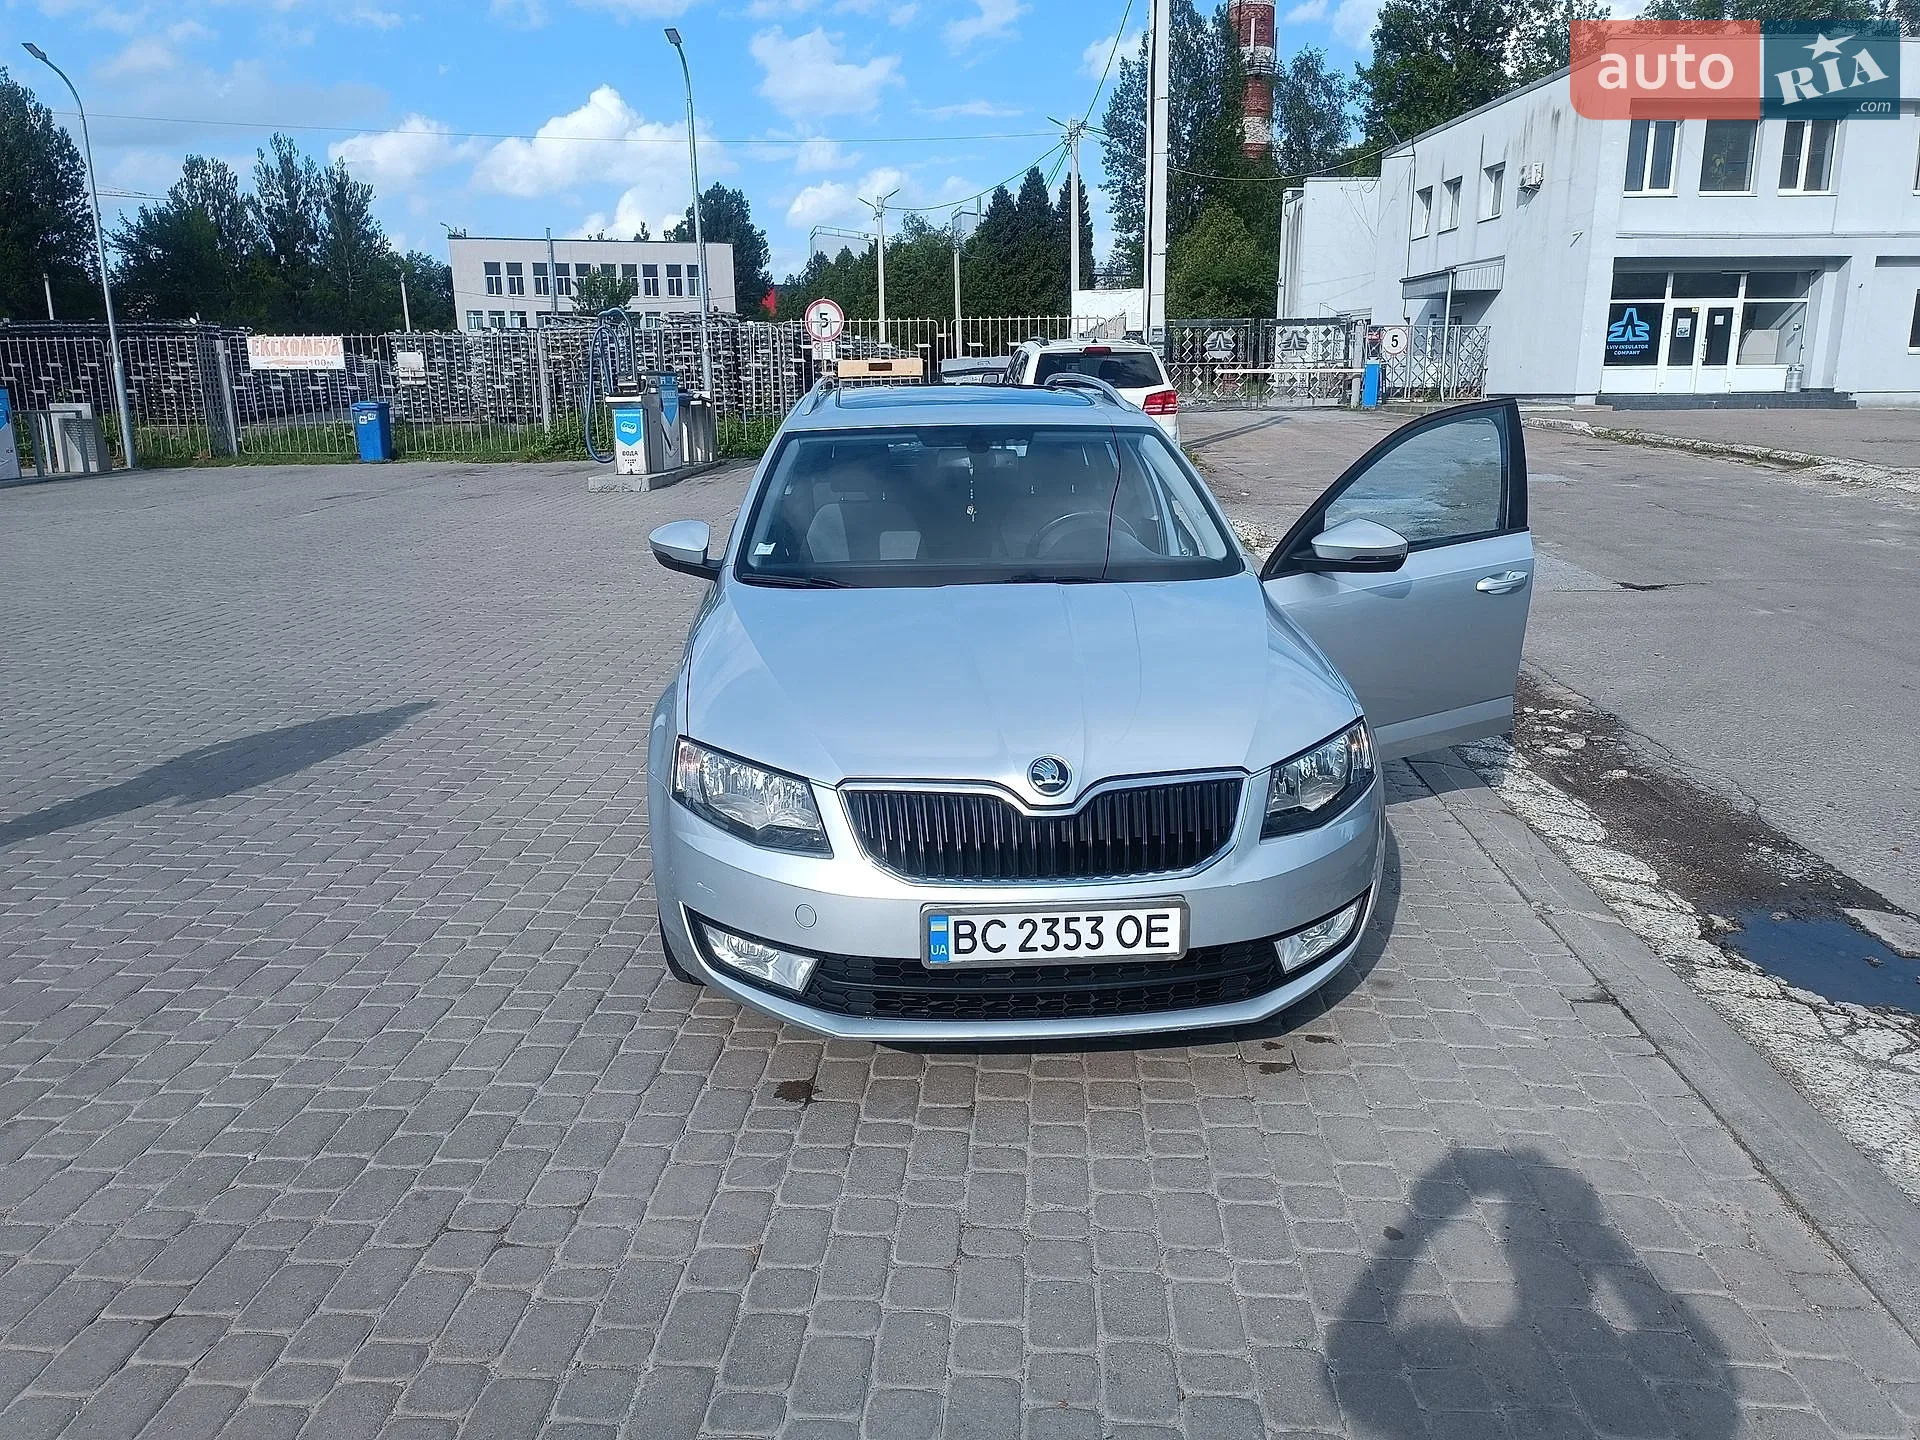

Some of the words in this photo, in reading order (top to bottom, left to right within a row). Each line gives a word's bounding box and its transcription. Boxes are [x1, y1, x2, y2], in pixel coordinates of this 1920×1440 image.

[819, 312, 829, 328] 5
[1391, 334, 1399, 348] 5
[953, 919, 1007, 955] BC
[1018, 916, 1104, 953] 2353
[1116, 914, 1170, 949] OE
[931, 944, 947, 956] UA
